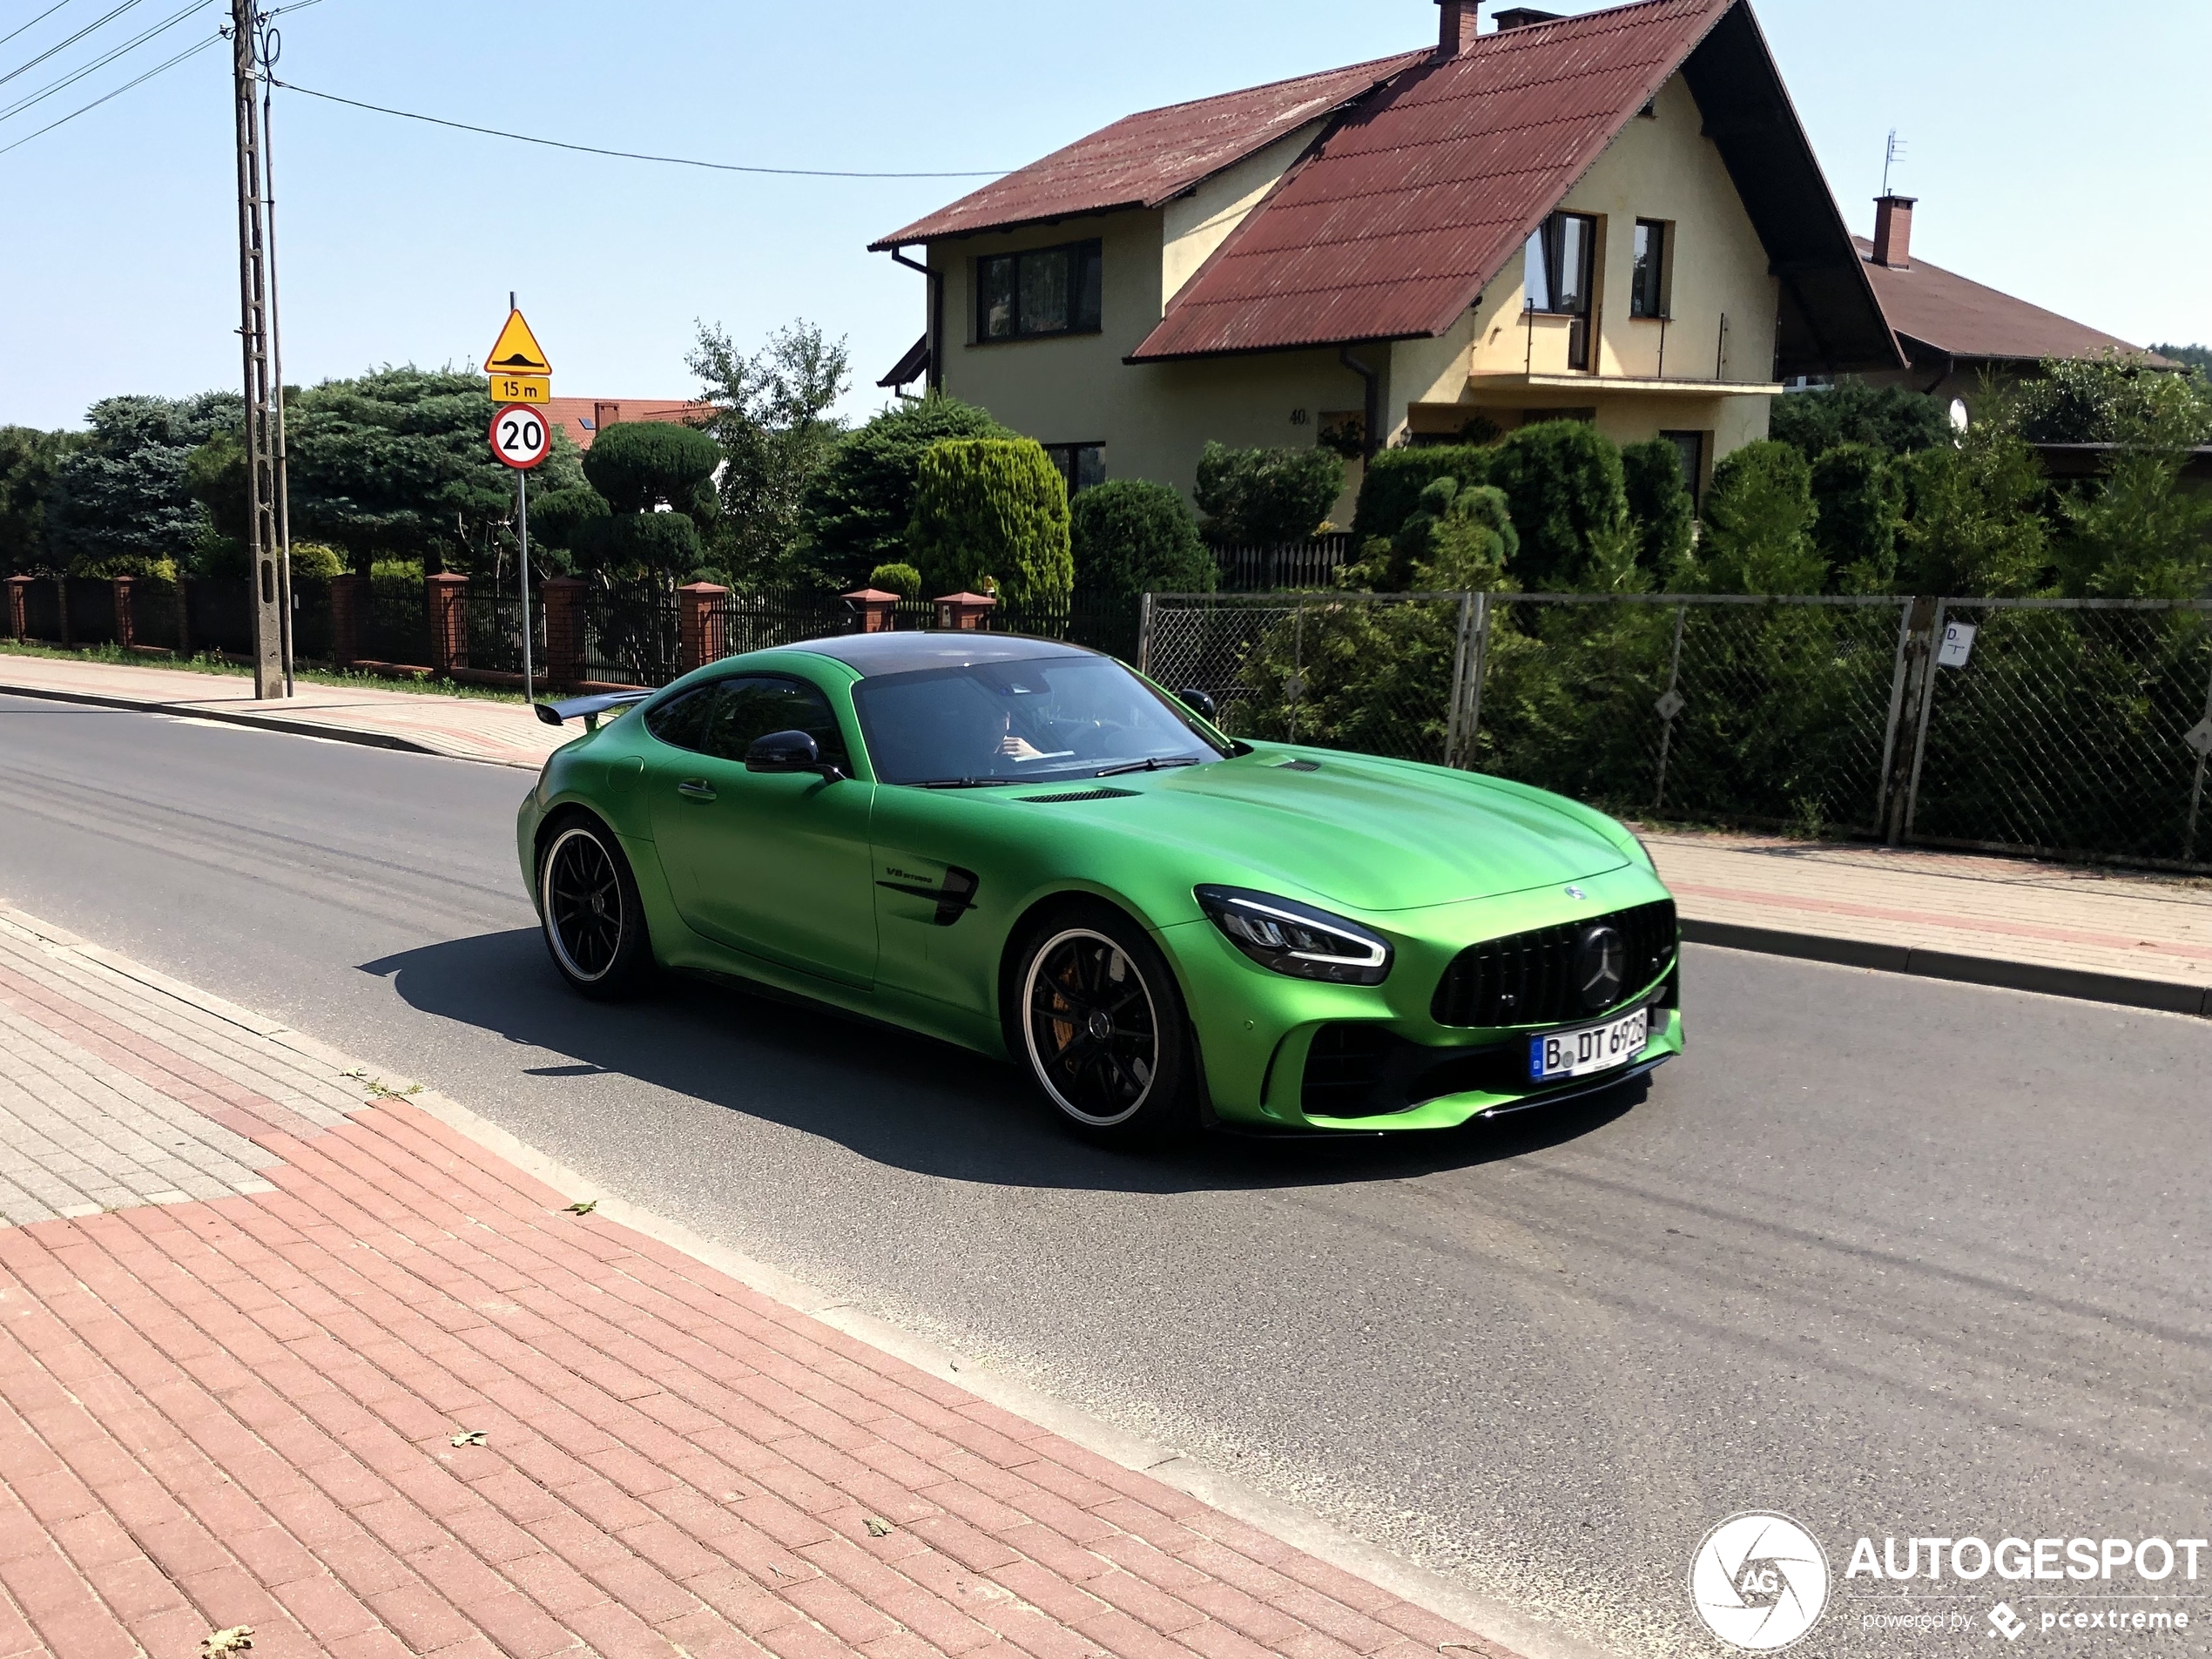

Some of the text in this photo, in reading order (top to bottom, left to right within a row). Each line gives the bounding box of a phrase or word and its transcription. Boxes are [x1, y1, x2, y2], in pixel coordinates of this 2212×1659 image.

[502, 381, 537, 398] 15 m
[502, 421, 542, 450] 20
[1546, 1039, 1560, 1069] B
[1578, 1028, 1606, 1062] DT
